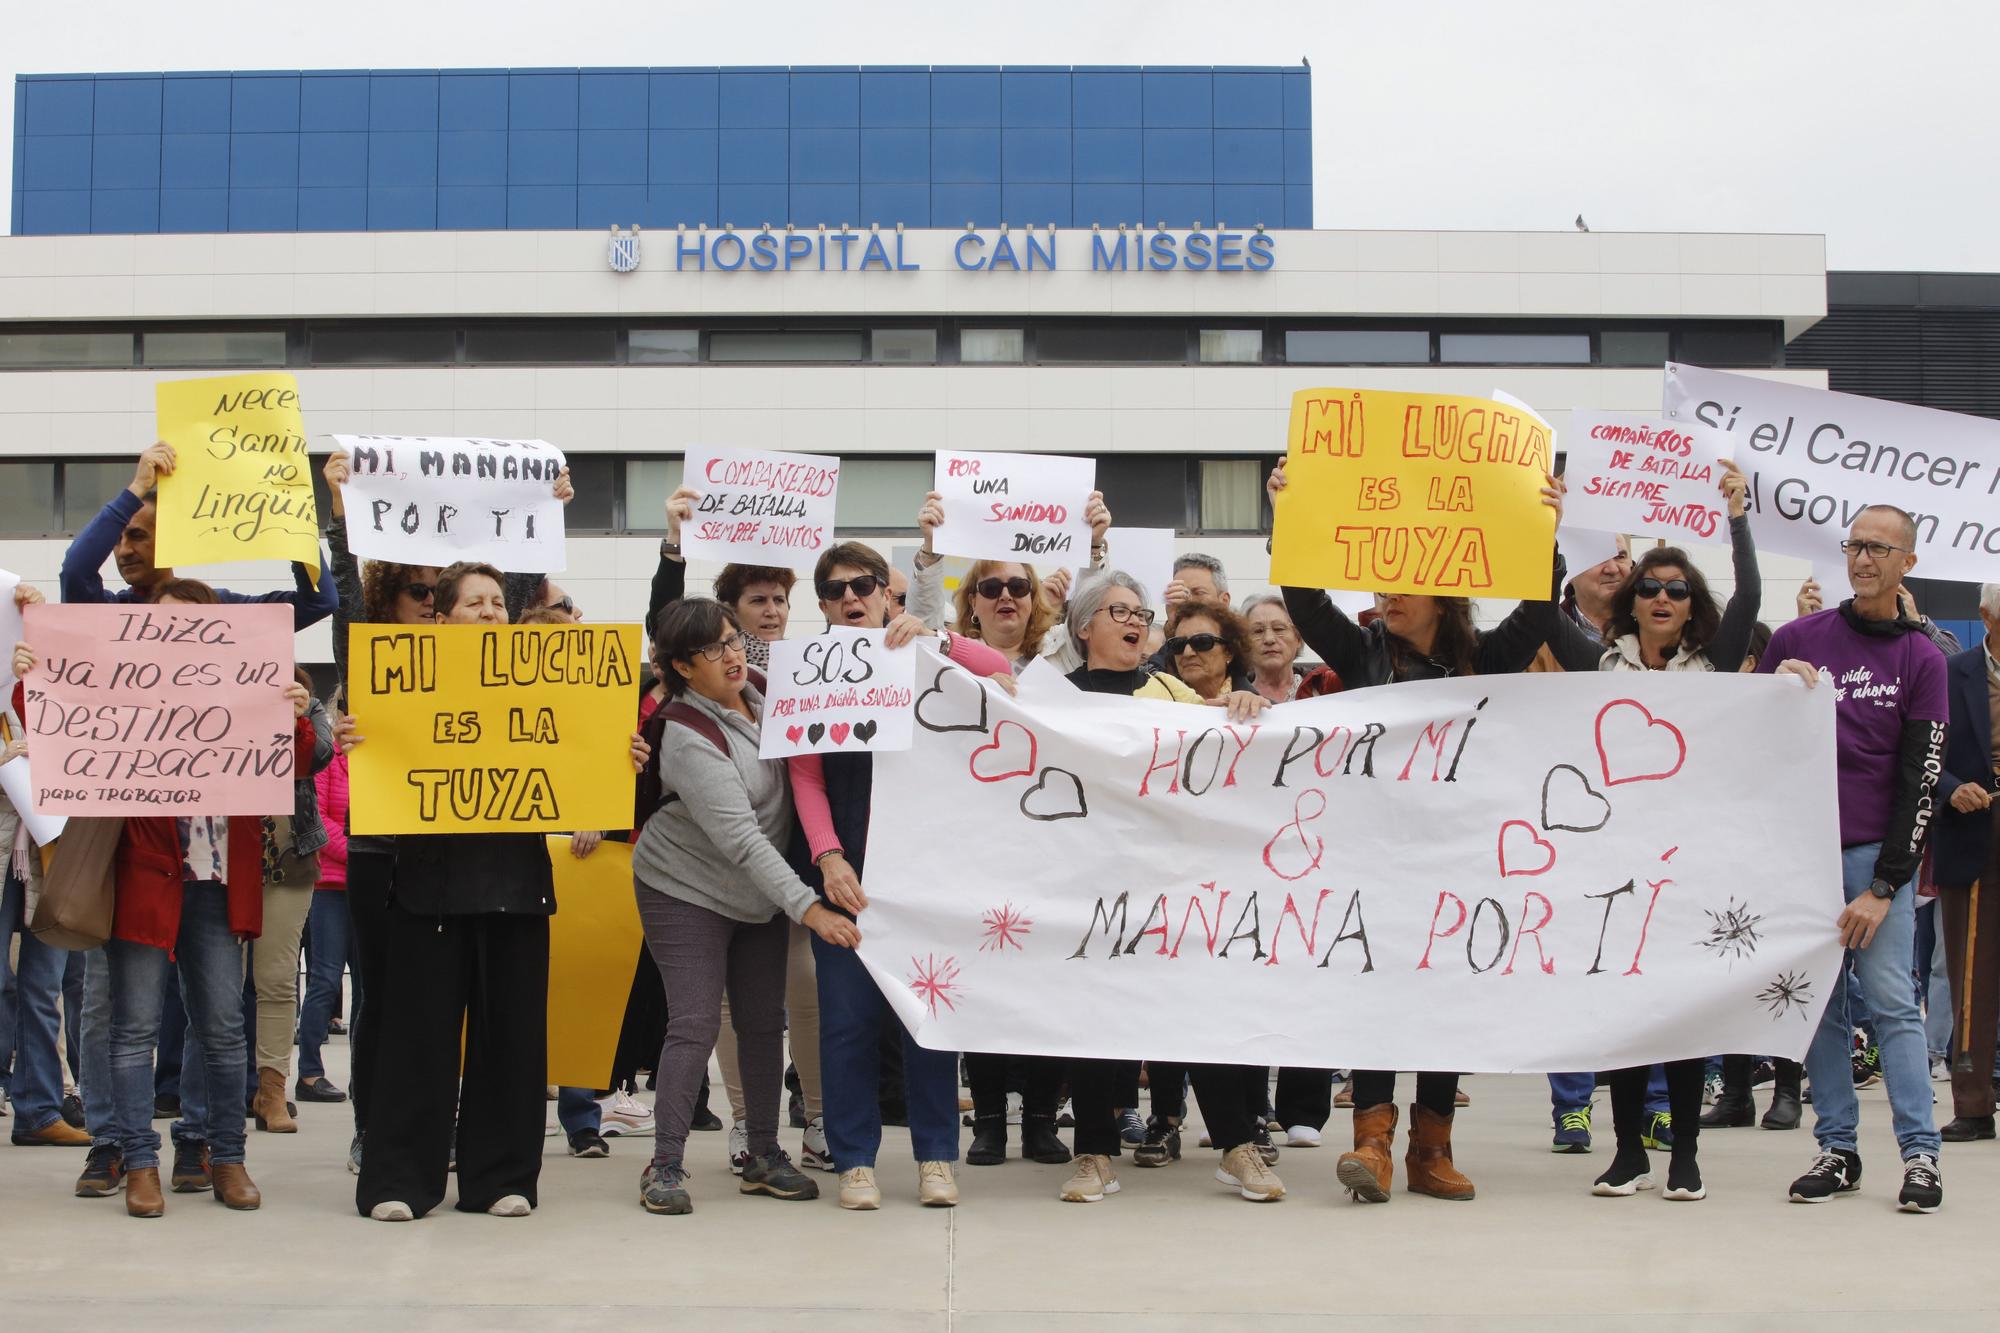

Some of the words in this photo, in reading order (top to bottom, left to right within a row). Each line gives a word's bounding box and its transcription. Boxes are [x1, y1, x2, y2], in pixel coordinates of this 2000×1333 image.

[676, 233, 920, 271] HOSPITAL
[954, 233, 1056, 271] CAN
[1092, 233, 1275, 271] MISSES
[1302, 392, 1365, 458] MI
[1402, 404, 1549, 474] LUCHA
[1590, 425, 1694, 458] COMPAÑEROS
[947, 458, 982, 477] POR
[1609, 450, 1635, 470] DE
[1636, 455, 1712, 484] BATALLA
[1749, 416, 1794, 456] el
[1807, 422, 1981, 490] Cancer
[705, 458, 838, 498] COMPAÑEROS
[973, 477, 1009, 495] UNA
[1357, 477, 1401, 511] ES
[1427, 476, 1474, 512] LA
[370, 499, 459, 537] POR
[697, 494, 728, 514] DE
[730, 493, 807, 518] BATALLA
[1642, 502, 1722, 538] JUNTOS
[1774, 478, 1940, 544] Govn
[761, 524, 823, 550] JUNTOS
[1335, 526, 1493, 588] TUYA
[45, 658, 98, 688] ya
[110, 661, 161, 690] no
[172, 662, 221, 686] es
[370, 633, 437, 694] MI
[480, 629, 632, 687] LUCHA
[1841, 666, 1873, 685] vida
[771, 696, 797, 718] POR
[799, 693, 820, 714] UNA
[433, 711, 481, 744] ES
[509, 707, 559, 744] LA
[1138, 723, 1262, 798] HOY
[1272, 722, 1387, 788] POR
[408, 768, 560, 821] TUYA
[1262, 788, 1327, 882] &
[1065, 881, 1375, 974] MAÑANA
[1416, 890, 1557, 976] POR
